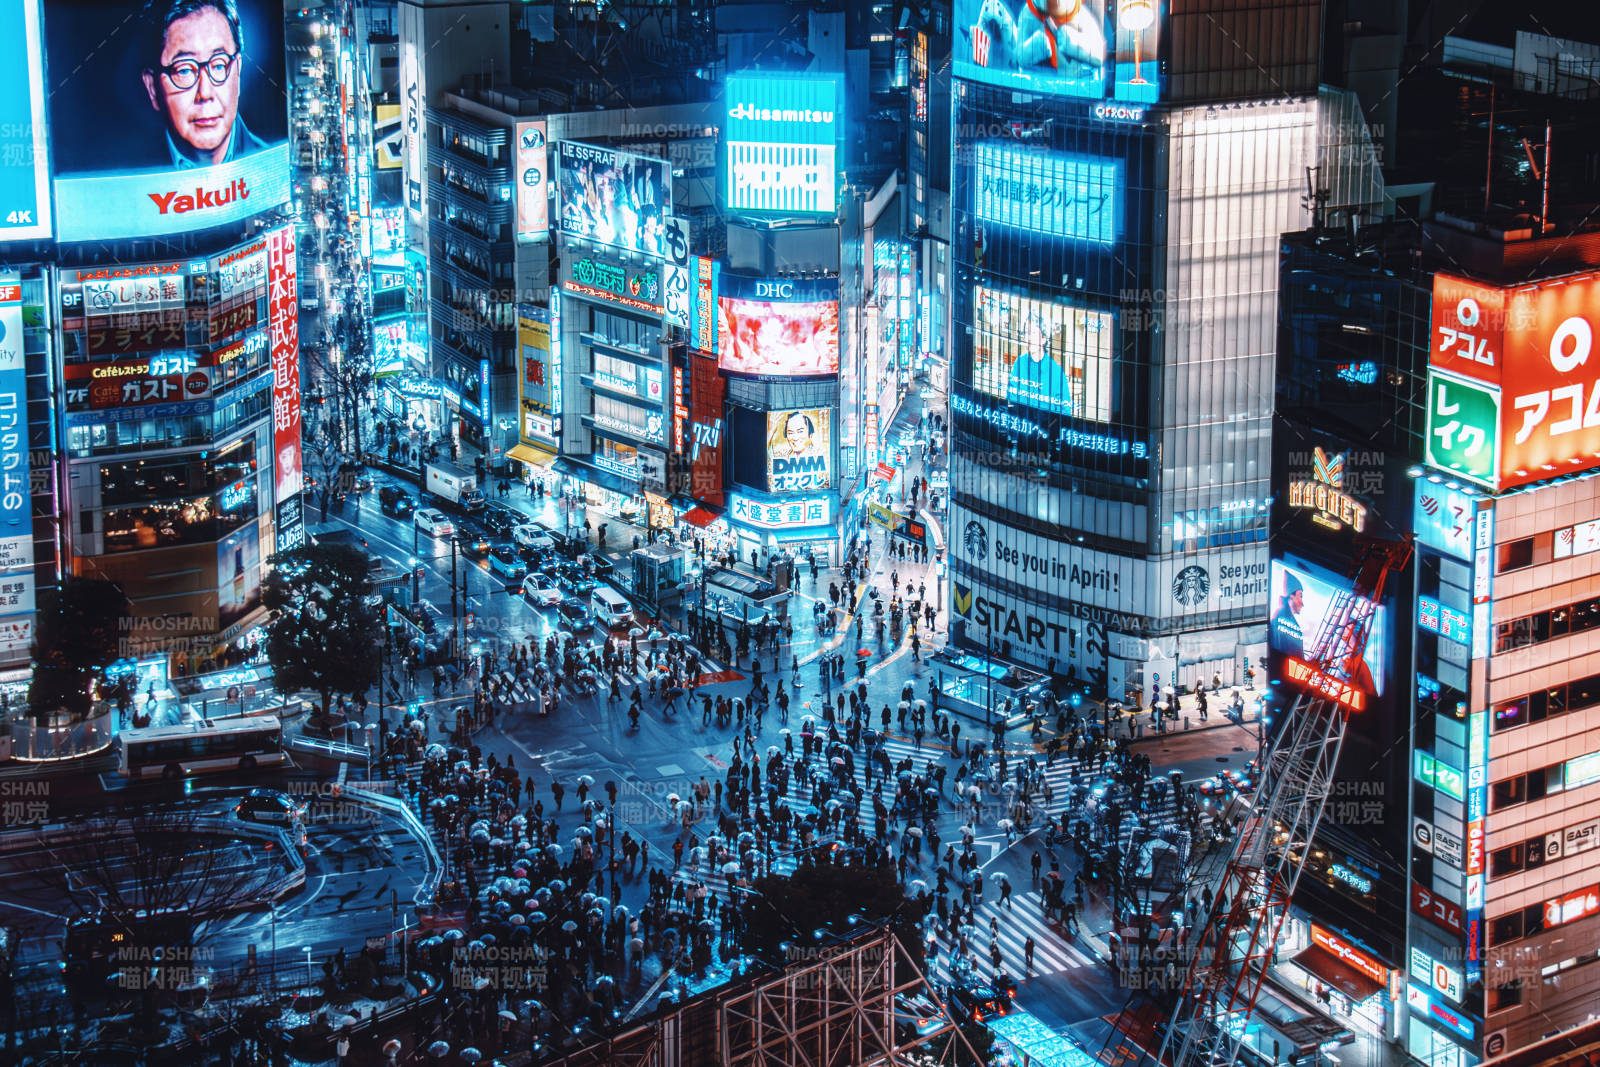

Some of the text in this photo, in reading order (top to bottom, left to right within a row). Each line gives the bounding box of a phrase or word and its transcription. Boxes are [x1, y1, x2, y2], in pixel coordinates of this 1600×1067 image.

[728, 103, 833, 123] Hisamitsu
[1095, 106, 1144, 121] QFRONT
[562, 144, 574, 158] LE
[147, 178, 250, 214] Yakult
[983, 174, 1109, 215] 大和証券グループ
[6, 210, 32, 223] 4K
[63, 293, 82, 306] 9F
[119, 282, 178, 303] しゃぶ葉
[756, 283, 793, 298] DHC
[245, 332, 268, 354] ガスト
[1439, 326, 1494, 366] アコム
[151, 354, 197, 377] ガスト
[67, 389, 88, 404] 7F
[122, 379, 178, 402] ガスト
[1514, 379, 1600, 445] アコム
[772, 455, 826, 475] DMM
[736, 499, 823, 523] 大盛堂書店
[1289, 480, 1367, 533] MAGNET
[995, 540, 1019, 566] See
[1022, 552, 1048, 575] you
[1052, 557, 1066, 581] in
[1220, 563, 1265, 580] See you
[1220, 584, 1231, 598] in
[975, 596, 1077, 659] START!
[1423, 759, 1460, 789] レイク
[1435, 833, 1460, 851] EAST
[1566, 824, 1597, 842] EAST
[1418, 891, 1460, 929] アコム
